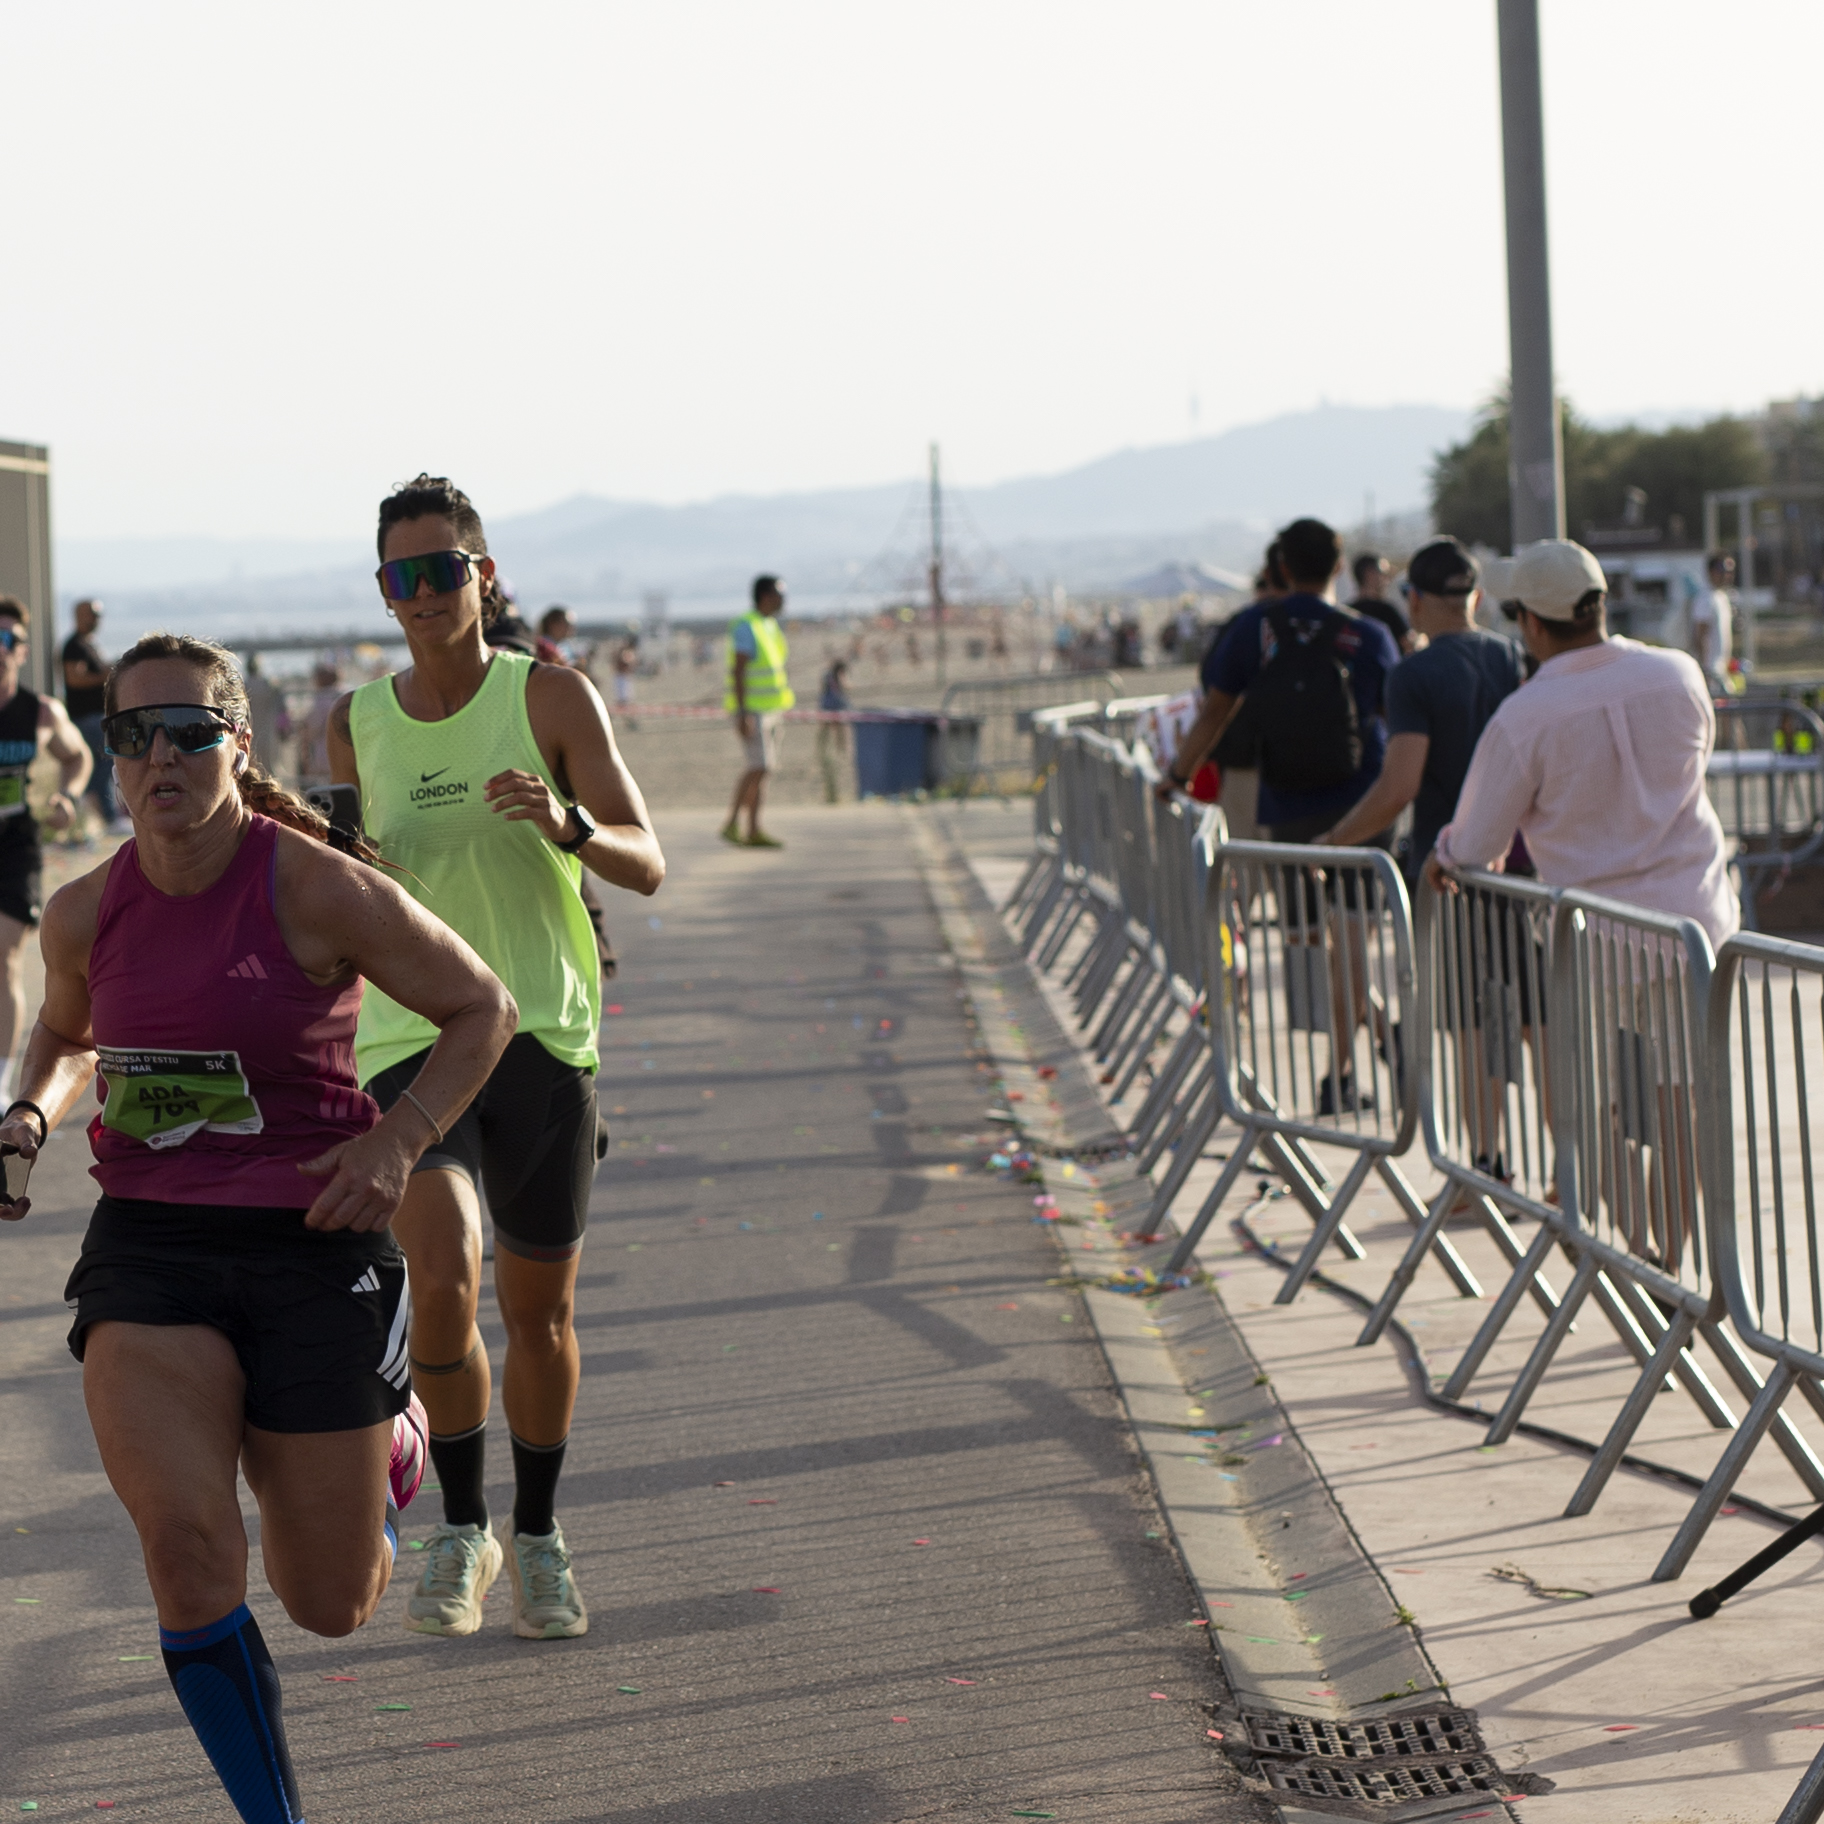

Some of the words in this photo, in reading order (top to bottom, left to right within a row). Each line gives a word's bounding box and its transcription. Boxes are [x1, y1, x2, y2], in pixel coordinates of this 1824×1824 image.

[409, 781, 469, 802] LONDON
[130, 1065, 153, 1073] MAR
[205, 1059, 227, 1071] 5K
[138, 1084, 190, 1103] ADA
